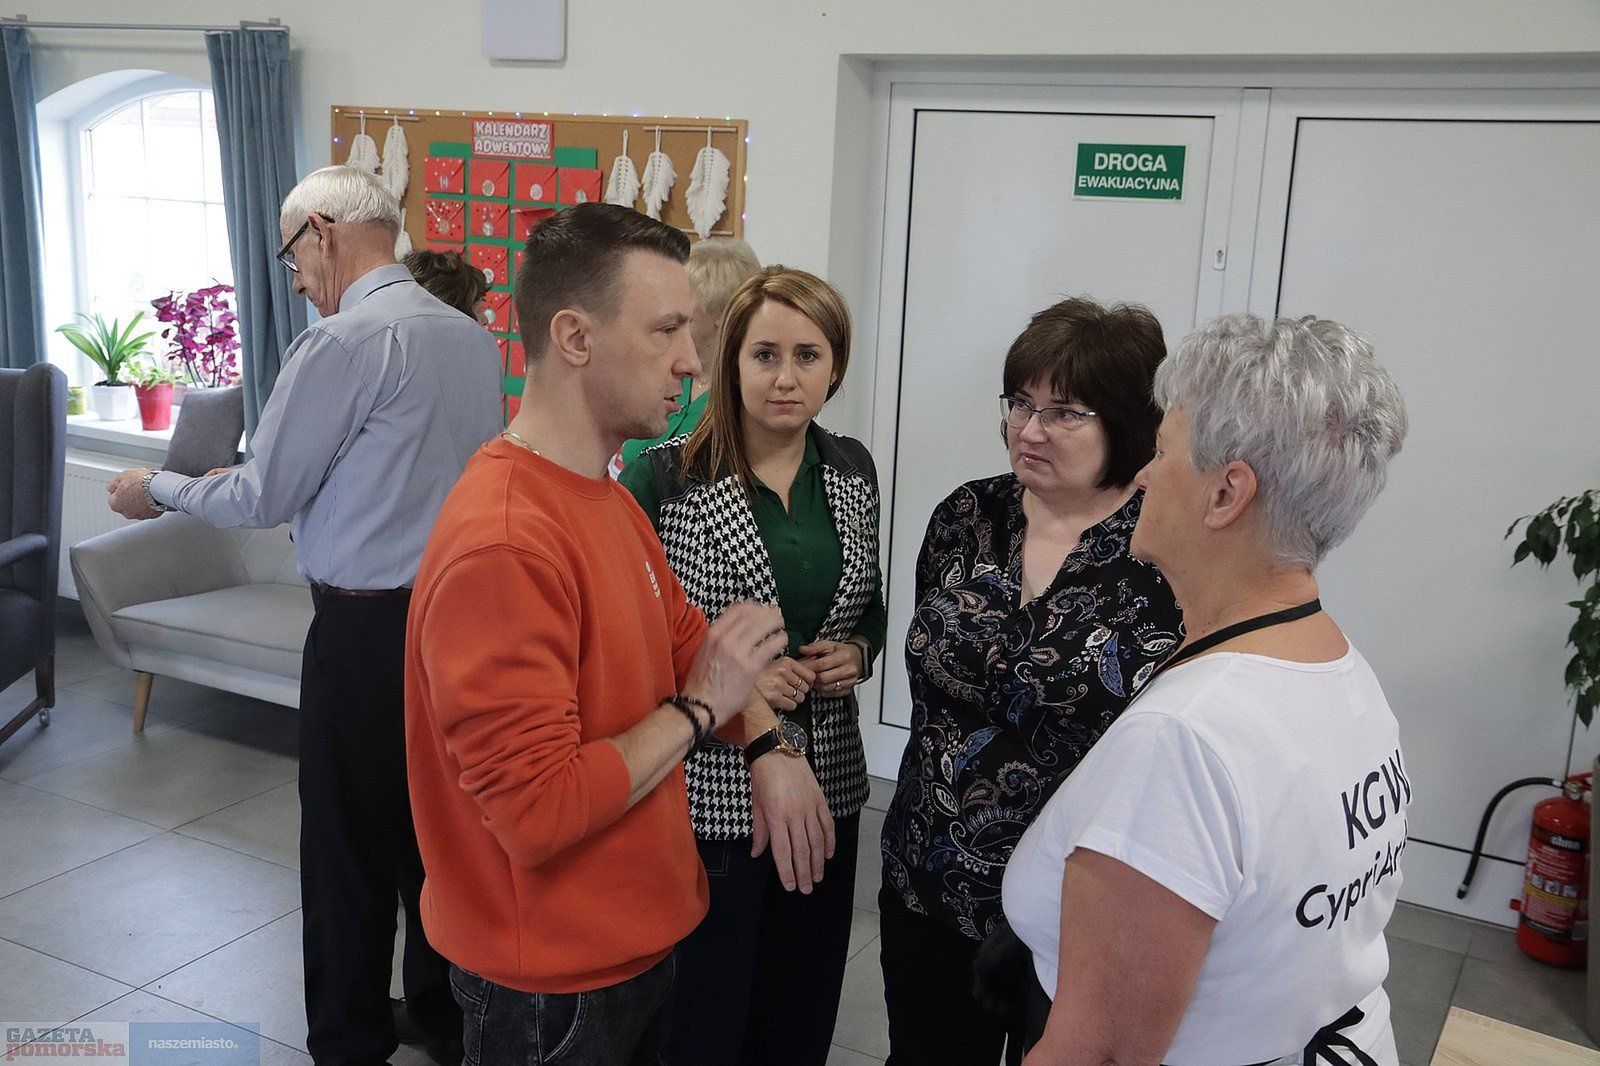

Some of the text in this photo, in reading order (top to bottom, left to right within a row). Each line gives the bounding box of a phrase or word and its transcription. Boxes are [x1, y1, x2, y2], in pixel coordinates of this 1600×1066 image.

[475, 121, 548, 139] KALENDARZ
[474, 139, 549, 156] ADWENTOWY
[1094, 152, 1168, 172] DROGA
[1078, 175, 1180, 191] EWAKUACYJNA
